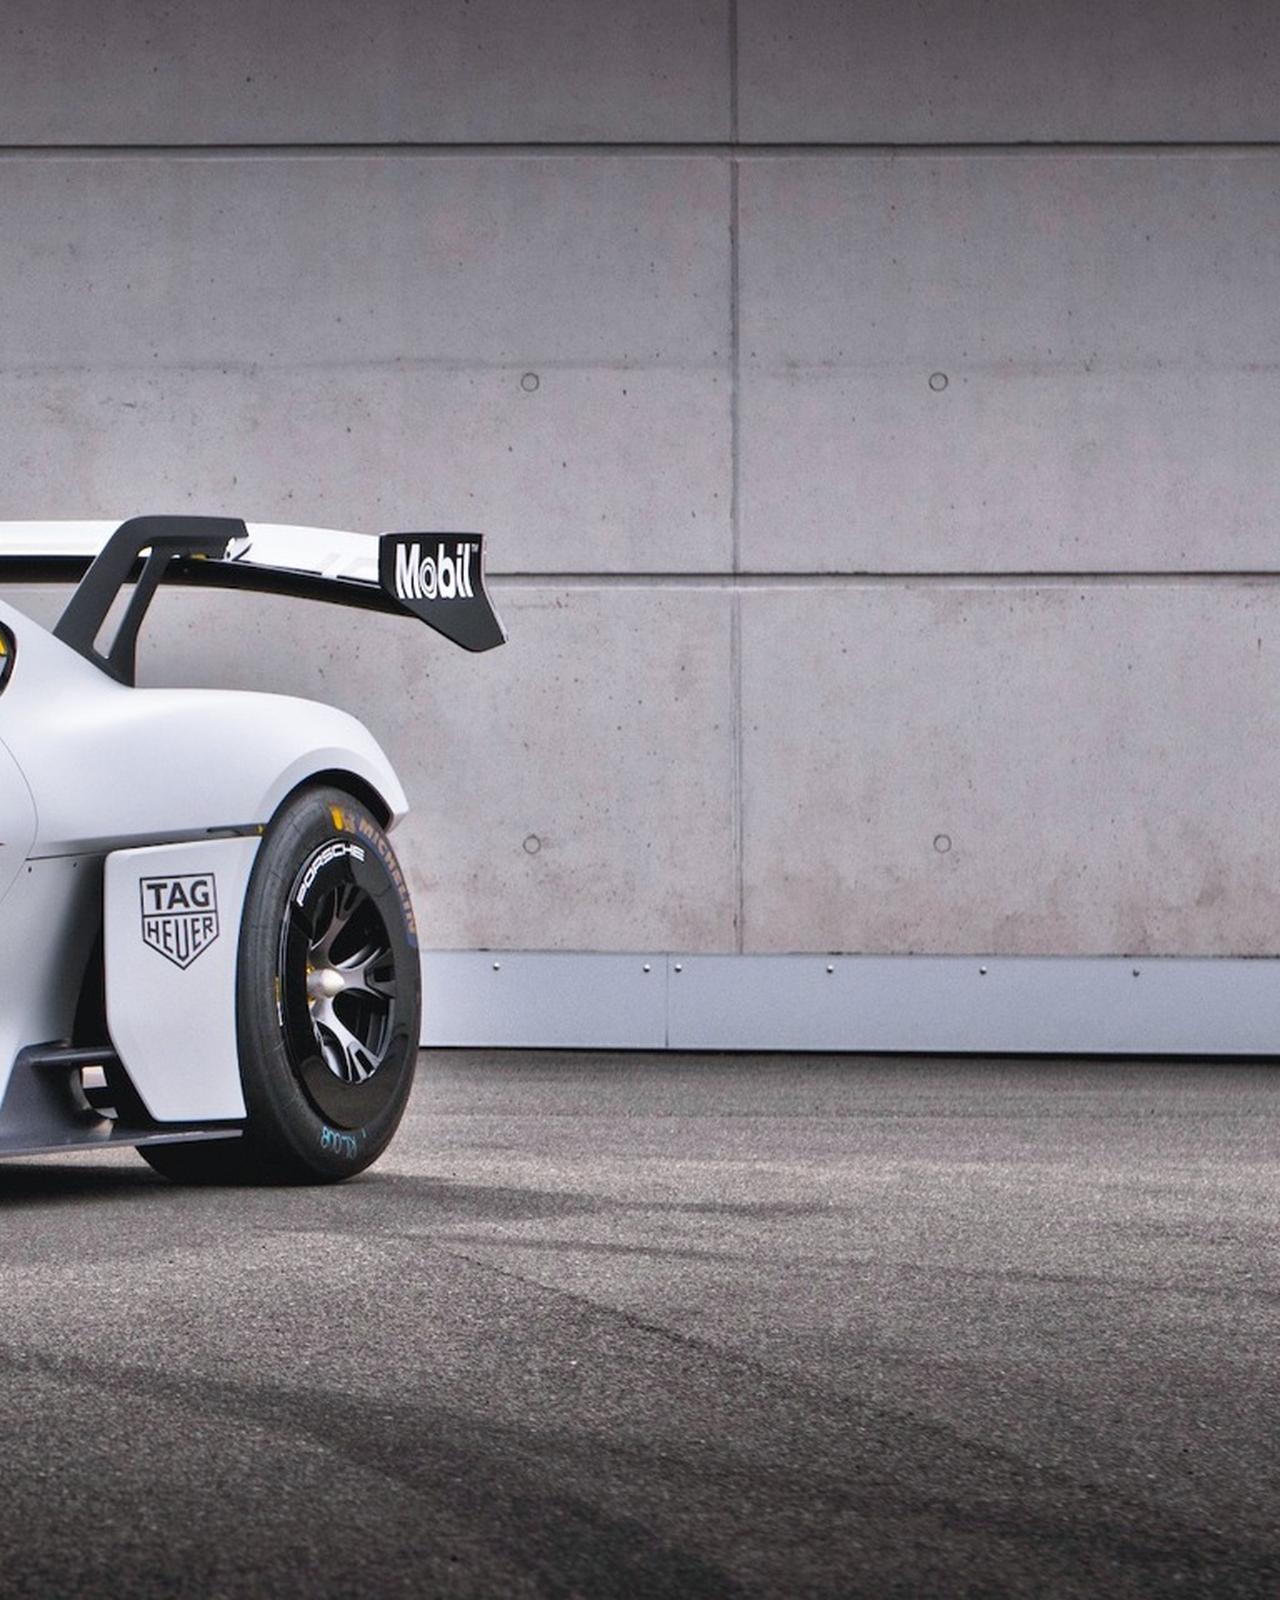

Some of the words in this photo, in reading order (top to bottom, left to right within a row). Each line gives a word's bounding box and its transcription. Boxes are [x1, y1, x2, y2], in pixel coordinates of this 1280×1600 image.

[396, 543, 474, 599] Mobil
[146, 880, 210, 910] TAG
[296, 842, 365, 908] PORSCHE
[147, 916, 214, 962] HEUER
